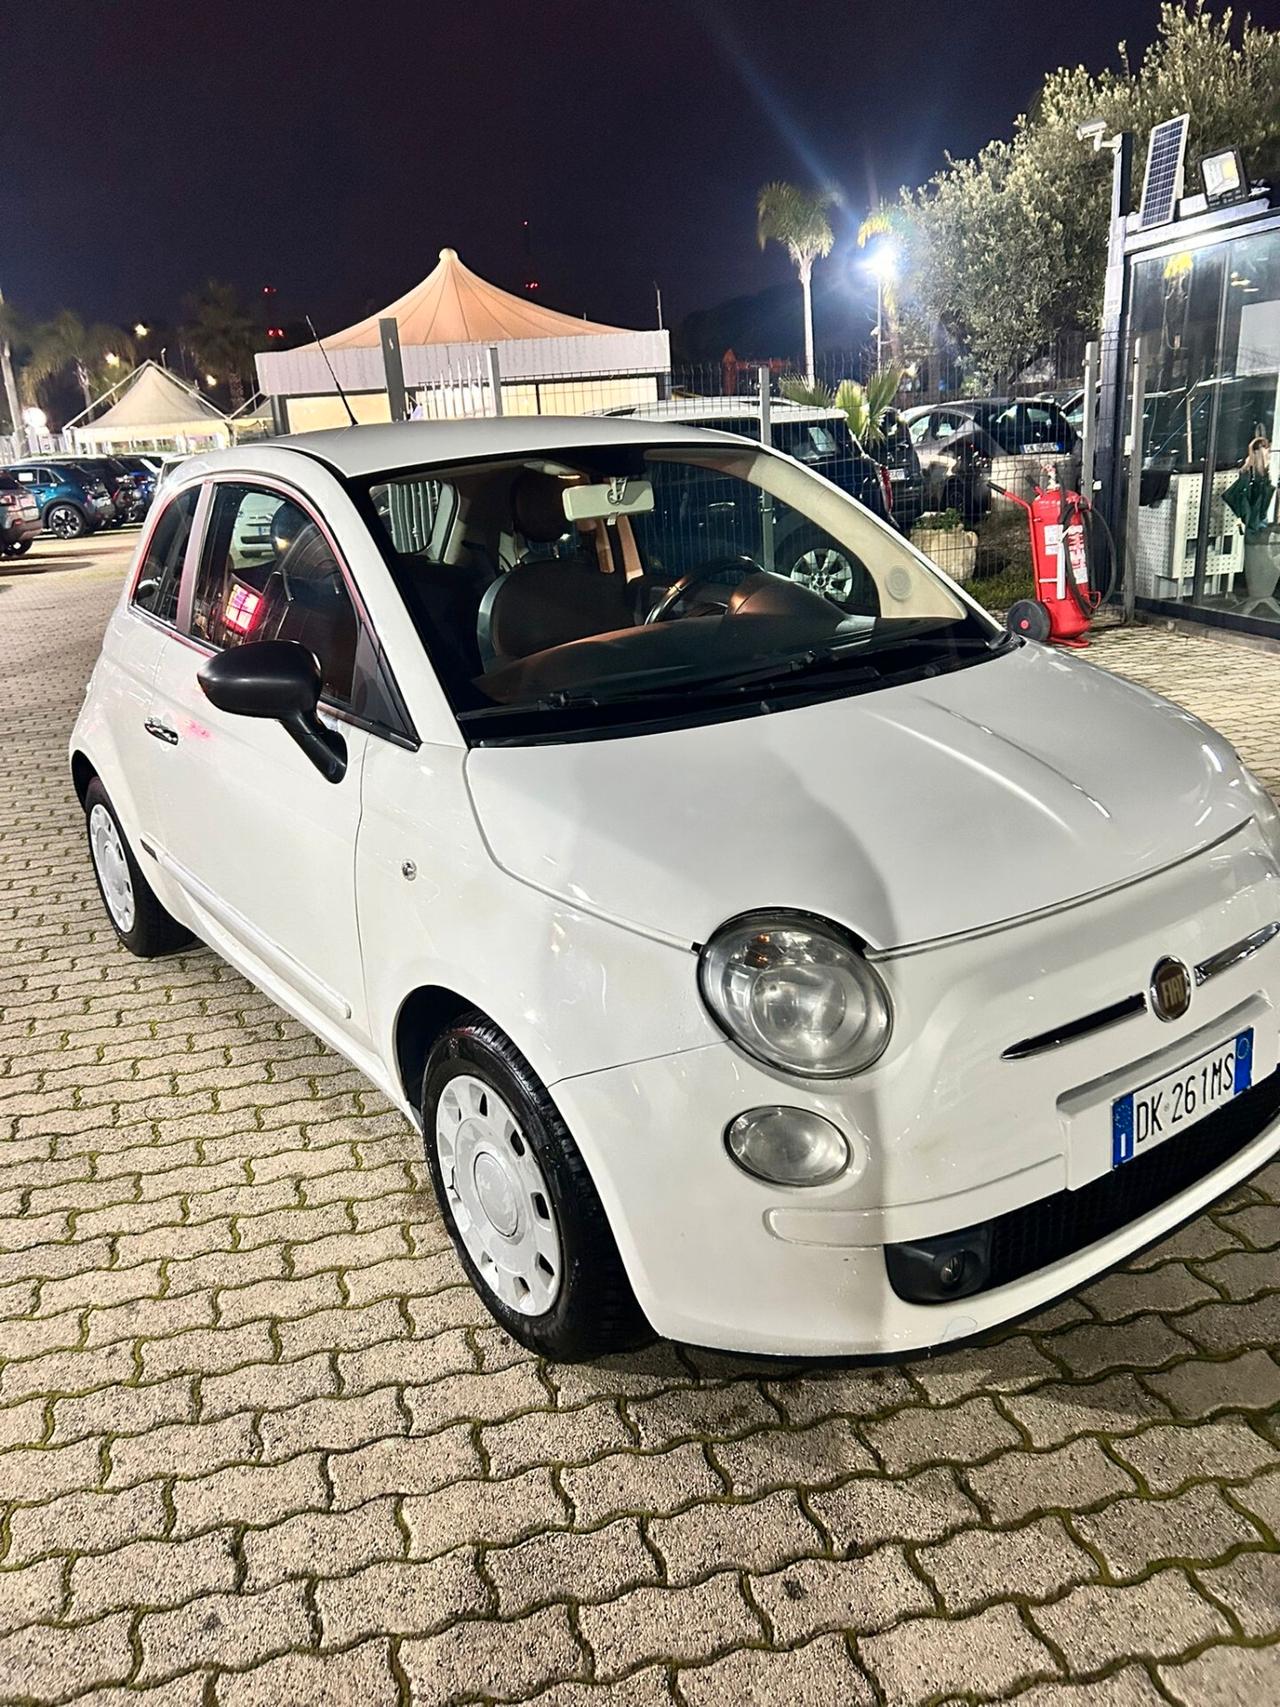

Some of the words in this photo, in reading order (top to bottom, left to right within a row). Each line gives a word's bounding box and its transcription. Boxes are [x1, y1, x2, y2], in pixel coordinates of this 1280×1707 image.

[1161, 973, 1186, 1009] FIAT
[1136, 1092, 1163, 1143] DK
[1171, 1052, 1234, 1123] 261MS
